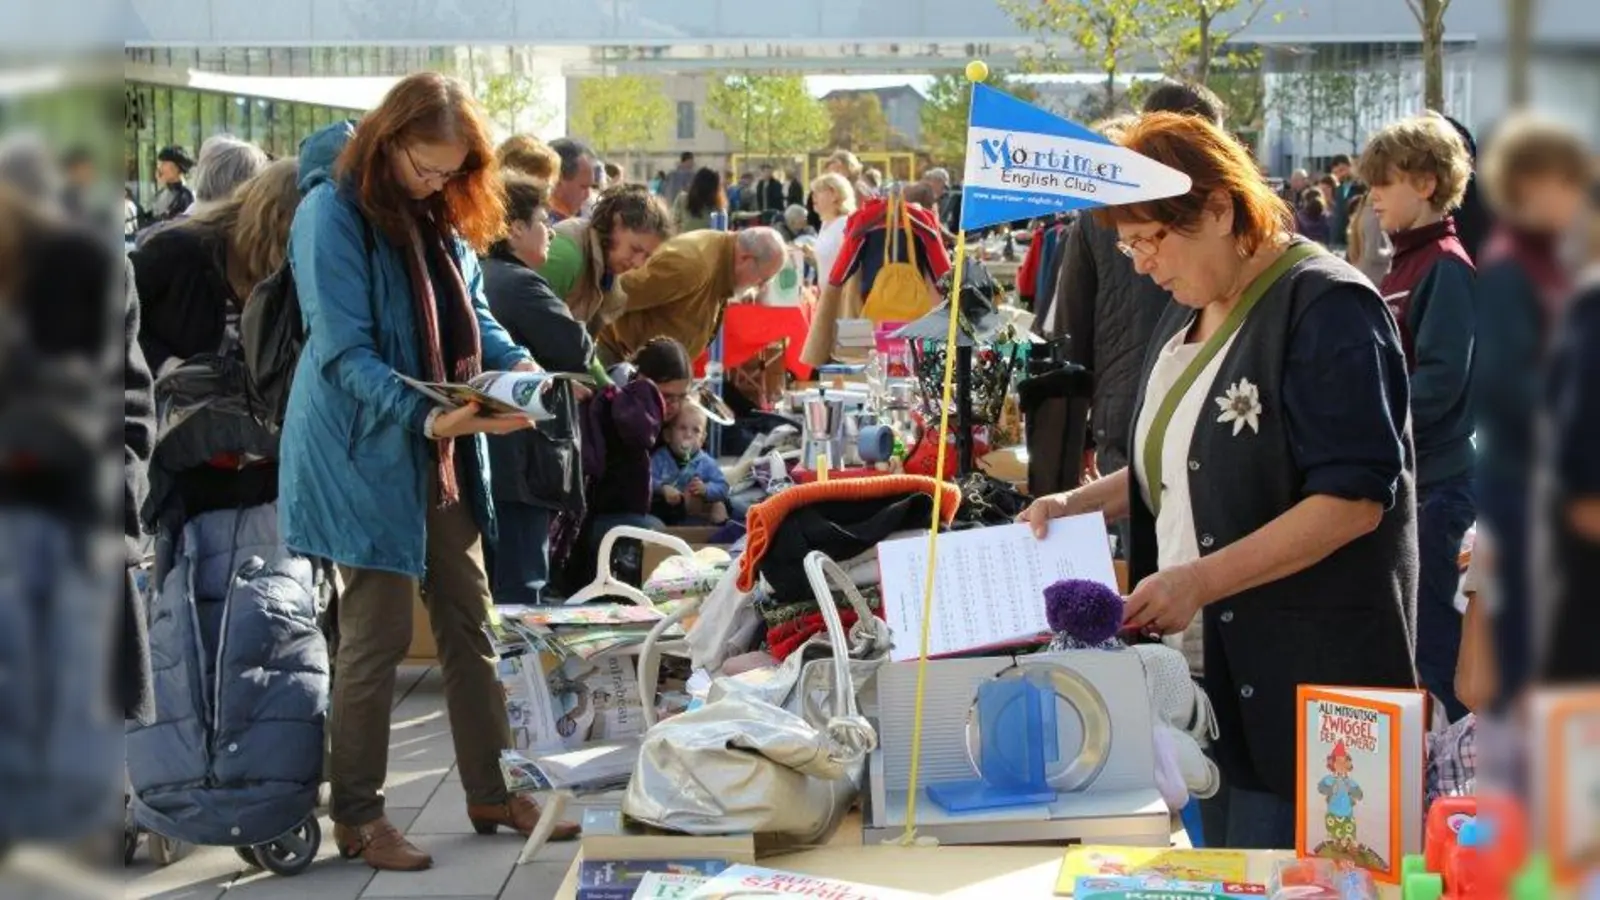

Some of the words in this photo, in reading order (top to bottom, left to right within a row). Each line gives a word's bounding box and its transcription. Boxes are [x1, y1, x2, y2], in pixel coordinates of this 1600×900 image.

[976, 133, 1122, 179] Mortimer
[1000, 169, 1058, 188] English
[1064, 176, 1097, 193] Club
[1319, 703, 1333, 715] ALI
